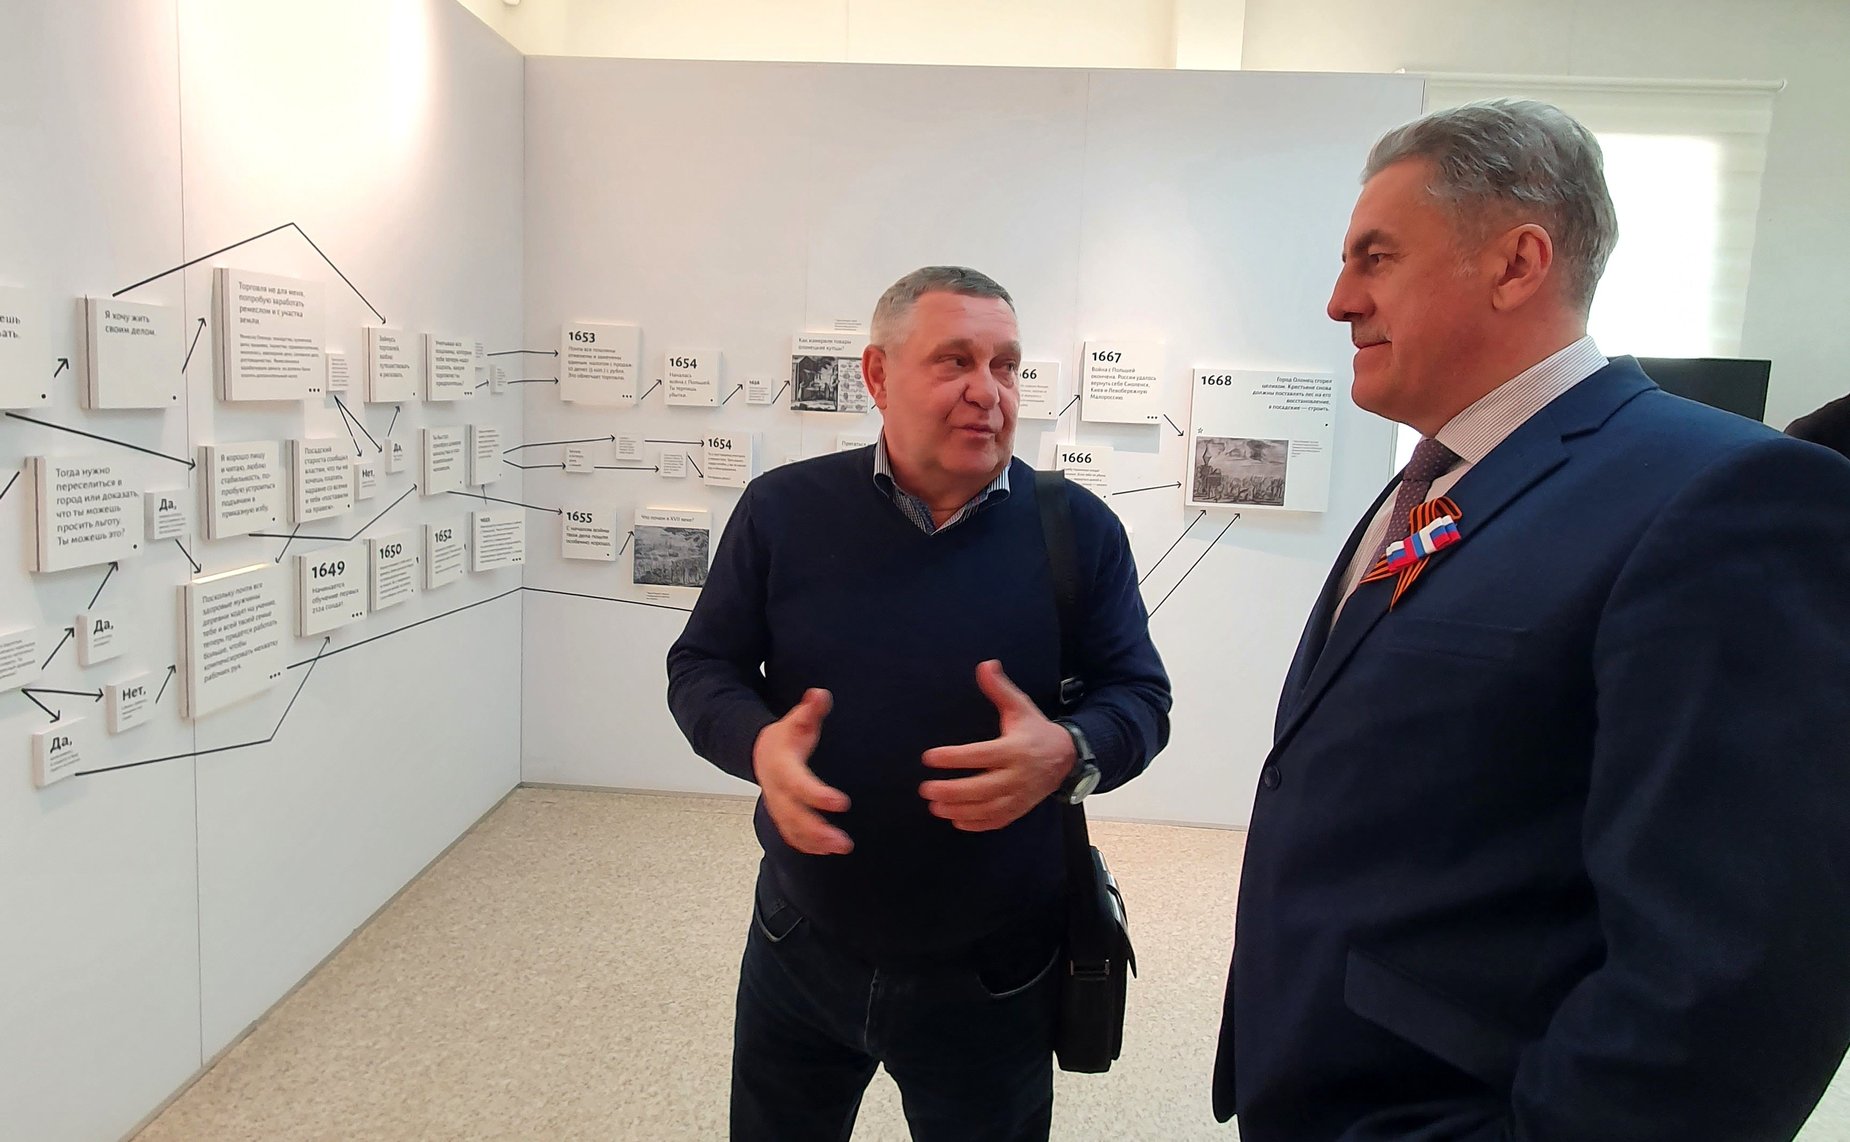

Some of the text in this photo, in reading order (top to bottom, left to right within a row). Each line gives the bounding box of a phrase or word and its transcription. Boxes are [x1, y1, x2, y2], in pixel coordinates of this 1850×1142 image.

[239, 281, 267, 293] Торговля
[239, 294, 305, 308] попробую заработать
[105, 310, 150, 323] Я хочу жить
[239, 305, 271, 315] ремеслом
[281, 309, 304, 318] участка
[105, 325, 130, 334] своим
[568, 330, 596, 343] 1653
[669, 357, 697, 369] 1654
[1092, 351, 1122, 364] 1667
[1112, 366, 1136, 374] Польшей
[1201, 374, 1232, 386] 1668
[1276, 376, 1292, 384] Город
[1293, 376, 1314, 384] Олонец
[1108, 388, 1148, 396] Левобережную
[1287, 383, 1315, 391] Крестьяне
[708, 437, 732, 450] 1654
[1062, 452, 1092, 464] 1666
[56, 466, 111, 478] Тогда нужно
[56, 480, 116, 492] переселиться
[56, 495, 83, 506] город
[84, 493, 101, 502] или
[158, 498, 177, 512] Да,
[56, 506, 121, 518] что ты можешь
[566, 512, 593, 524] 1655
[57, 522, 93, 534] просить
[57, 528, 126, 546] Ты можешь это?
[434, 528, 452, 543] 1652
[379, 543, 402, 560] 1650
[312, 560, 345, 579] 1649
[202, 582, 263, 603] Поскольку почти все
[233, 593, 260, 606] мужчины
[93, 619, 114, 635] Да,
[122, 686, 147, 701] Нет,
[50, 736, 73, 753] Да,
